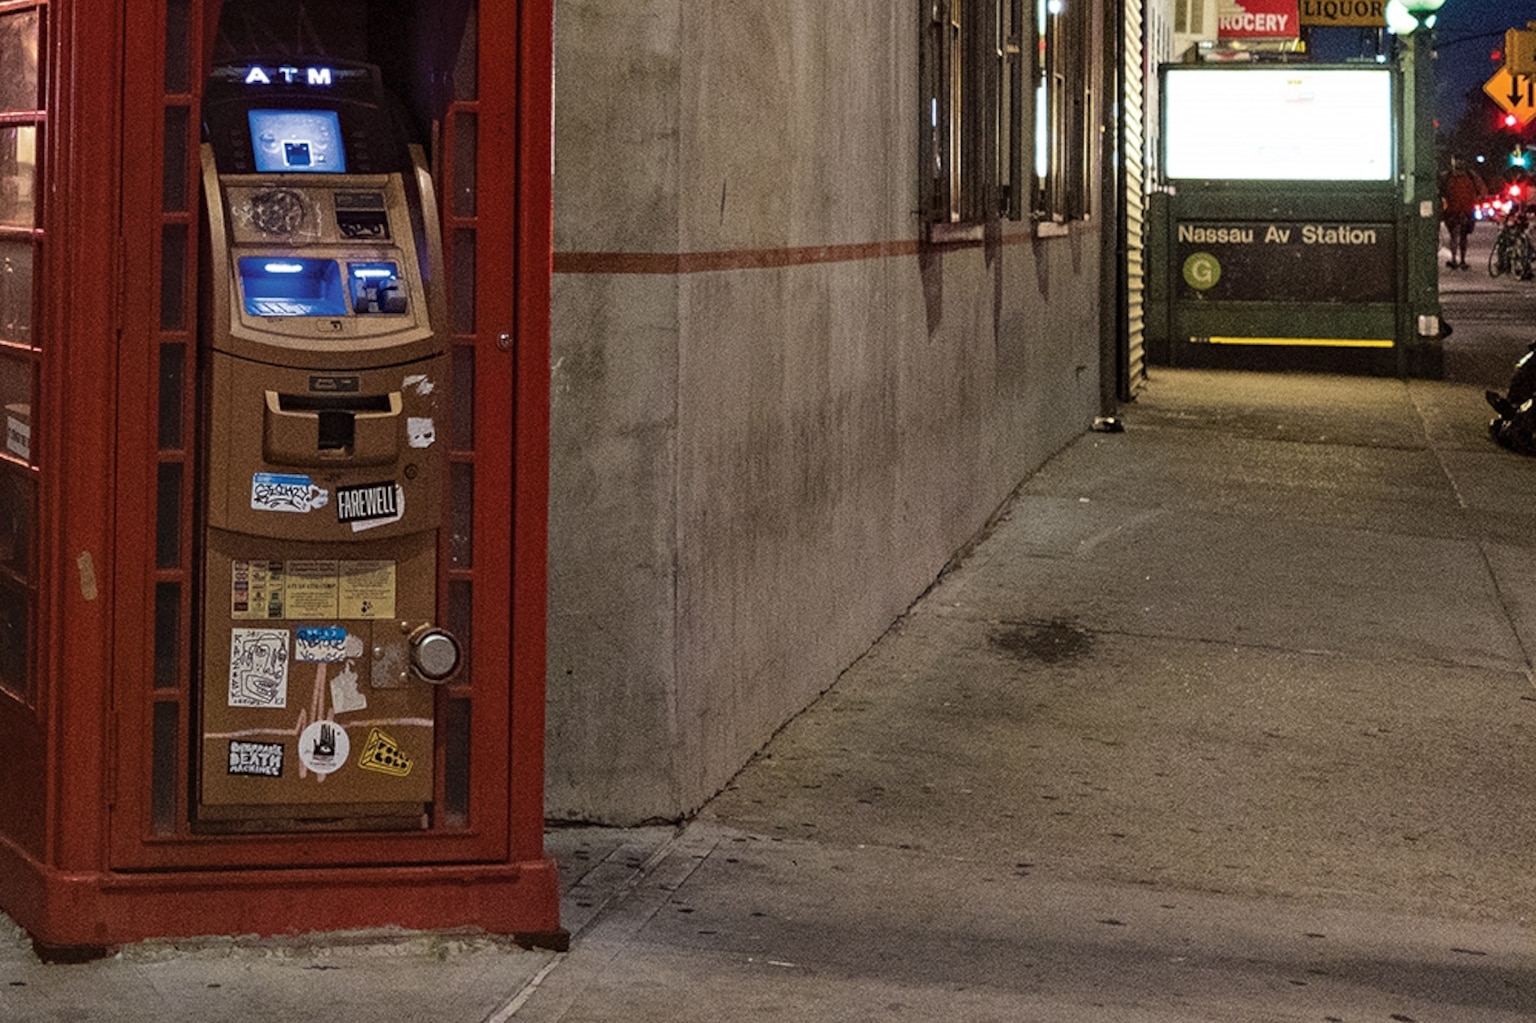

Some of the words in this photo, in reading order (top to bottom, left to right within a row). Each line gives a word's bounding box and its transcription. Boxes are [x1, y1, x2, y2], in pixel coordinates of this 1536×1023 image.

[245, 66, 333, 85] ATM
[1178, 225, 1254, 244] Nassau
[1265, 225, 1290, 244] Av
[1302, 225, 1376, 245] Station
[1191, 259, 1213, 282] G
[337, 485, 396, 519] FAREWELL
[230, 752, 282, 768] DEATH
